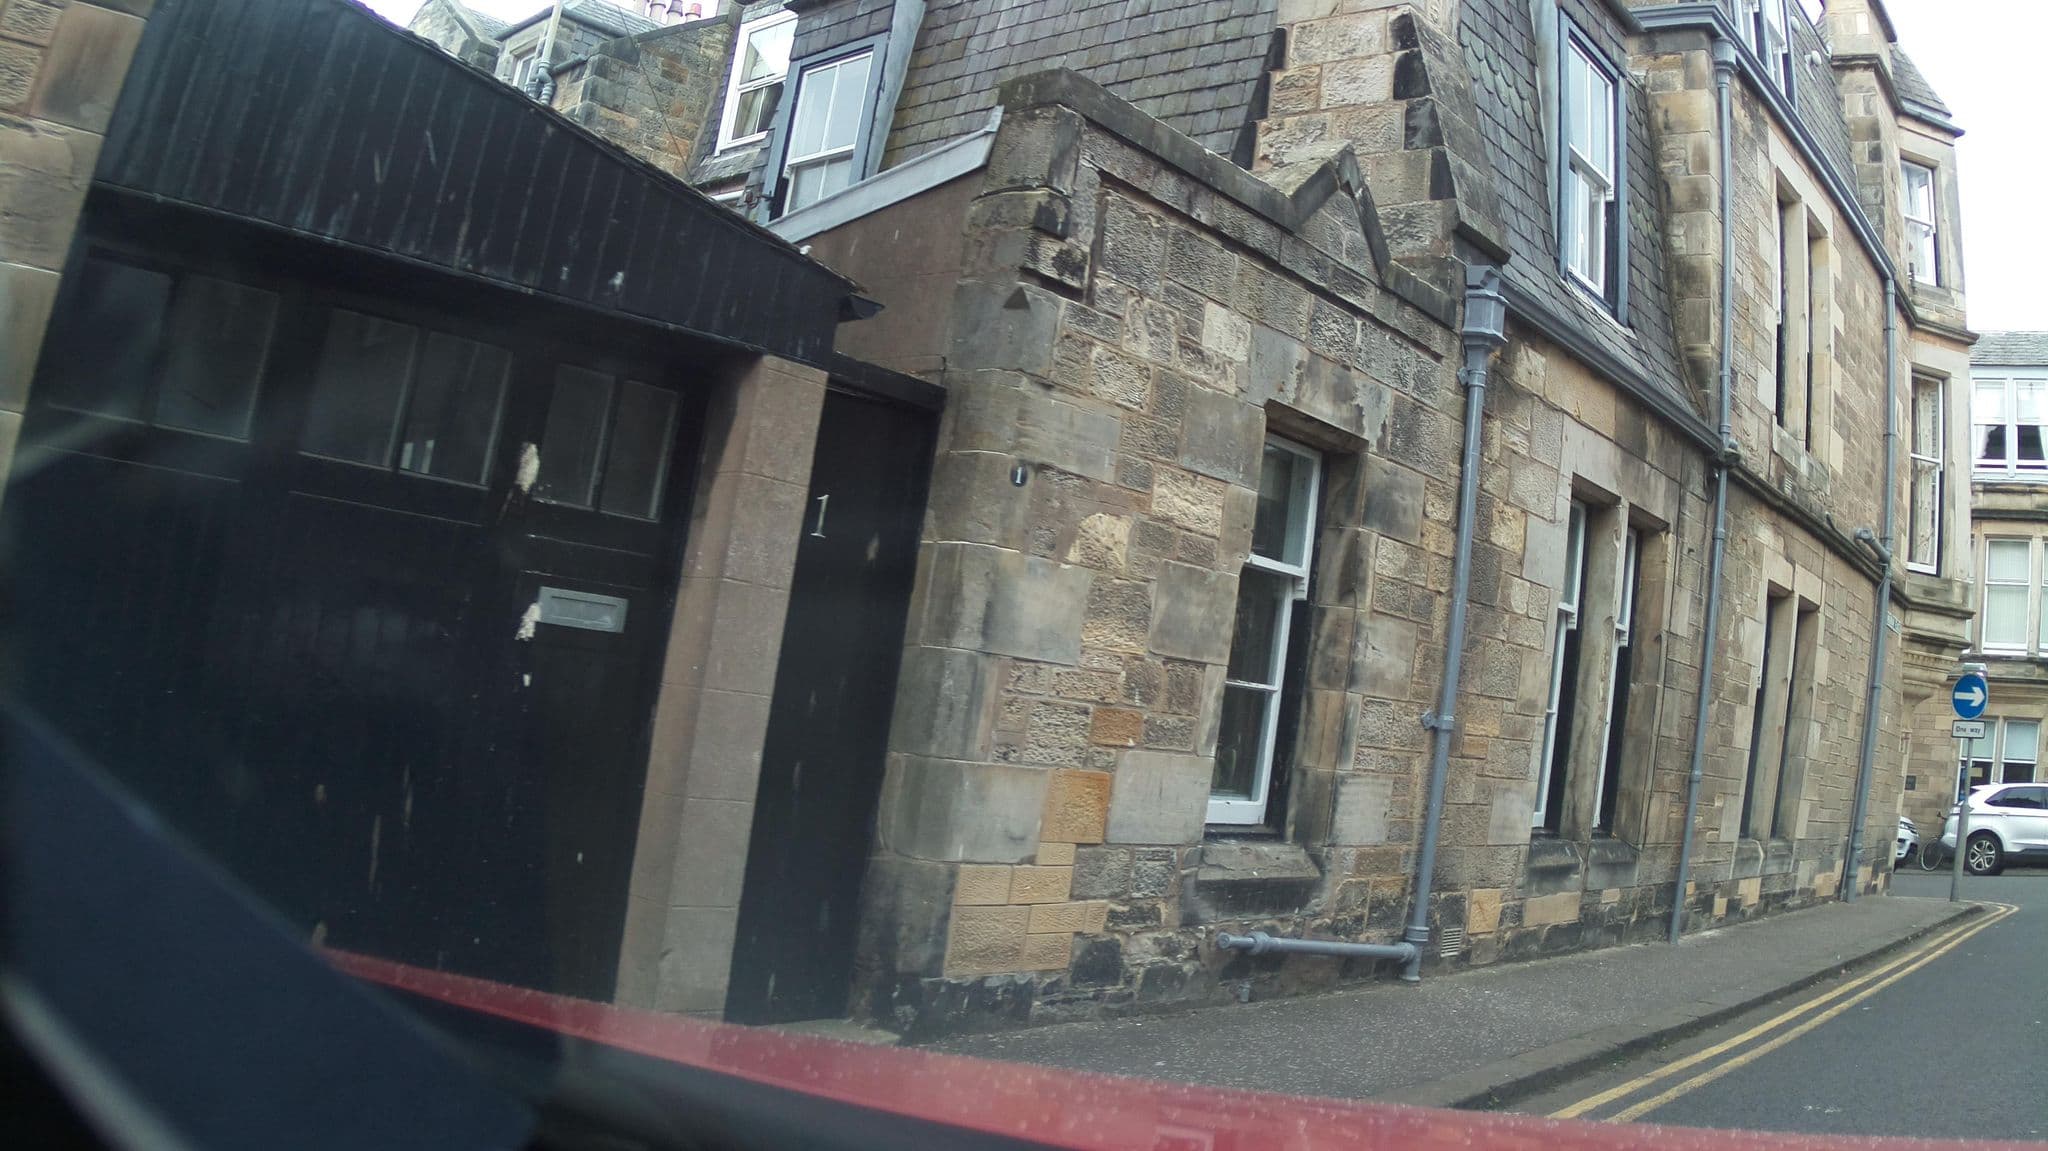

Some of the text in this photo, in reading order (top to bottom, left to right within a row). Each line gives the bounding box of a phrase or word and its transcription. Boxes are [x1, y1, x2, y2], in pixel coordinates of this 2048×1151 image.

[1015, 466, 1022, 484] 1
[810, 494, 830, 539] 1
[1955, 725, 1967, 733] One
